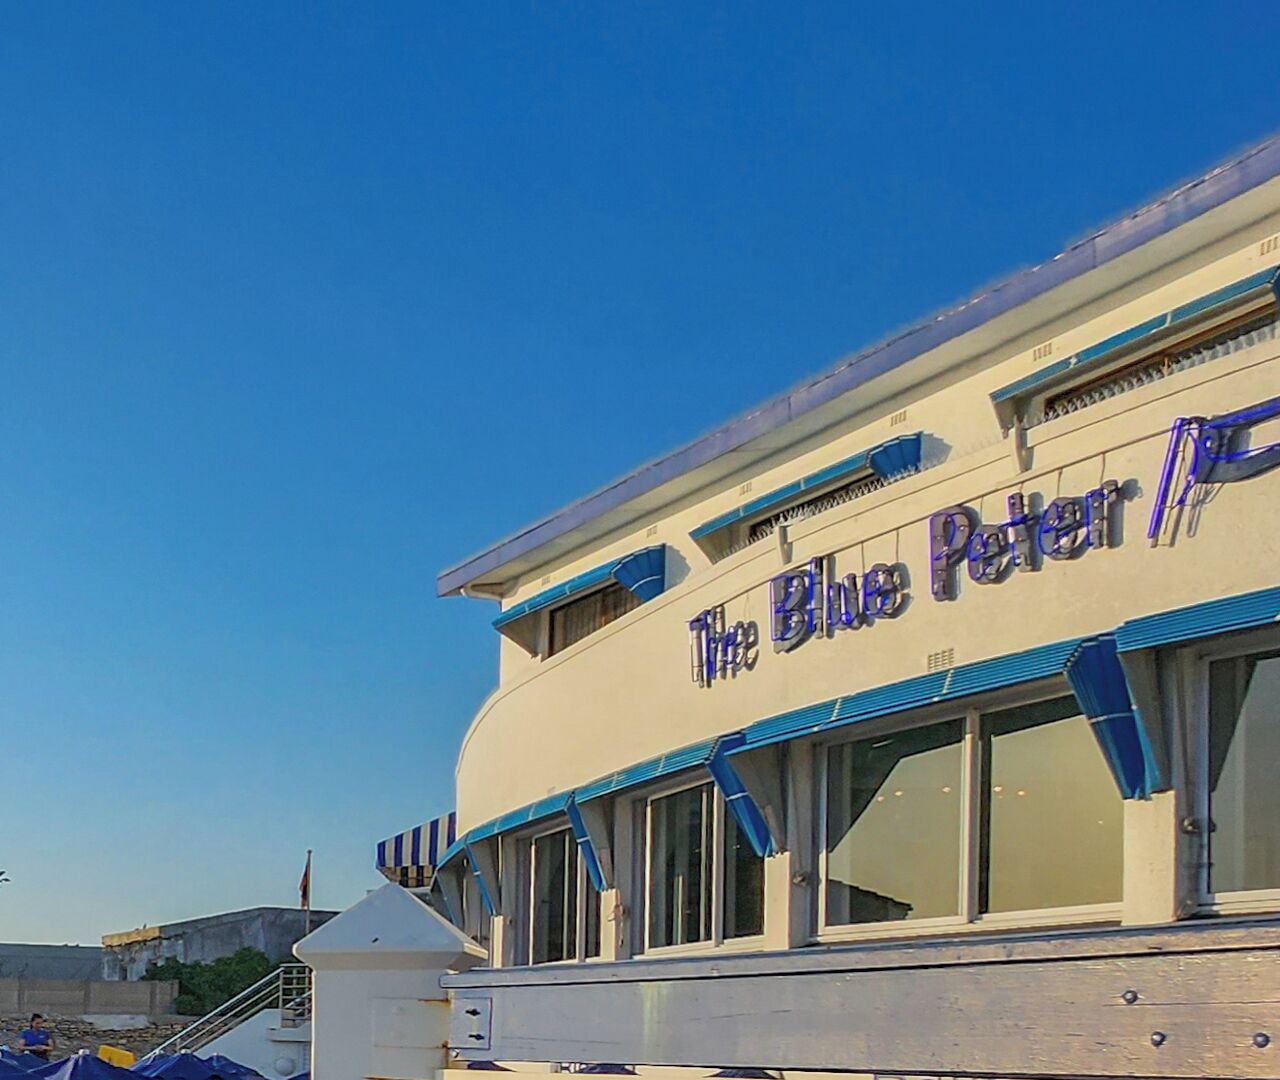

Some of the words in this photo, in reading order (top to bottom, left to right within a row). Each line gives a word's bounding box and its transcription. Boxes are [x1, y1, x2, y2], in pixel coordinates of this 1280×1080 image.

[688, 604, 759, 688] The
[769, 556, 904, 654] Blue
[929, 479, 1122, 602] Peter
